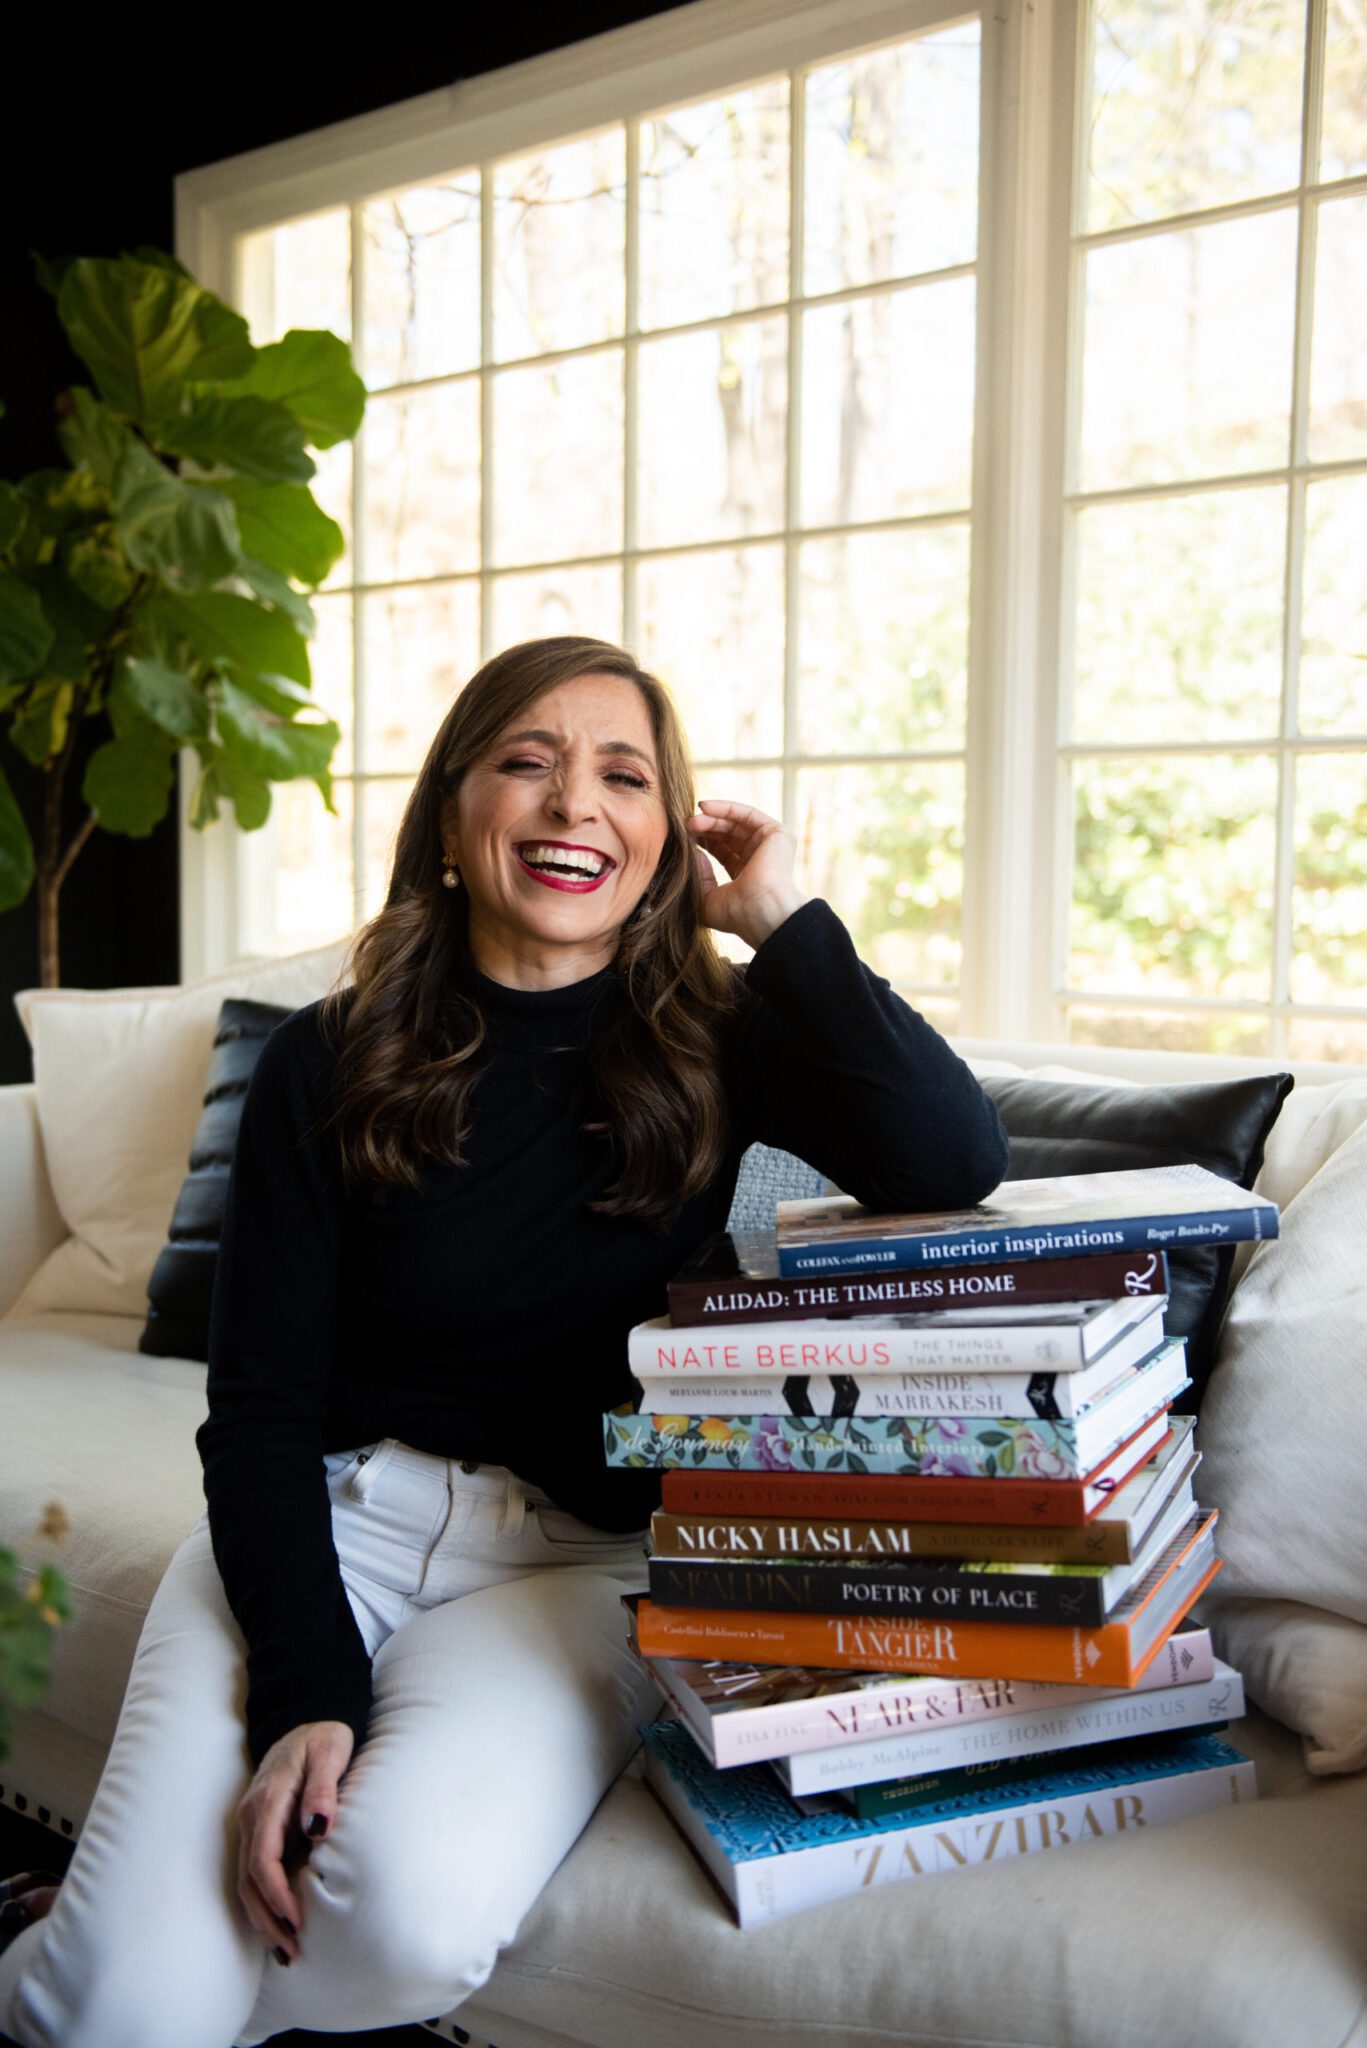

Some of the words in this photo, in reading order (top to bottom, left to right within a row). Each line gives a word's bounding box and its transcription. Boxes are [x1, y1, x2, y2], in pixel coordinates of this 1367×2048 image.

[921, 1241, 999, 1260] interior
[1005, 1229, 1124, 1255] inspirations
[1147, 1227, 1177, 1241] Roger
[703, 1291, 789, 1312] ALIDAD:
[794, 1287, 839, 1305] THE
[843, 1279, 944, 1302] TIMELESS
[948, 1274, 1016, 1295] HOME
[657, 1346, 741, 1368] NATE
[757, 1343, 891, 1367] BERKUS
[913, 1339, 939, 1351] THE
[948, 1338, 1004, 1351] THINGS
[907, 1355, 944, 1366] THAT
[951, 1354, 1013, 1365] MATTER
[902, 1373, 972, 1392] INSIDE
[875, 1393, 1003, 1411] MARRAKESH
[656, 1422, 750, 1464] Gournay
[677, 1525, 768, 1551] NICKY
[778, 1527, 912, 1553] HASLAM
[842, 1583, 925, 1604] POETRY
[931, 1586, 962, 1605] OF
[970, 1588, 1039, 1609] PLACE
[858, 1615, 928, 1632] INSIDE
[828, 1619, 958, 1661] TANGIER
[827, 1695, 917, 1738] NEAR
[925, 1694, 947, 1720] &
[955, 1680, 1017, 1714] FAR
[819, 1757, 865, 1777] Bobby
[872, 1743, 942, 1768] McAlpine
[960, 1729, 1002, 1752] THE
[1008, 1719, 1071, 1744] HOME
[1076, 1703, 1154, 1731] WITHIN
[1160, 1700, 1186, 1717] US
